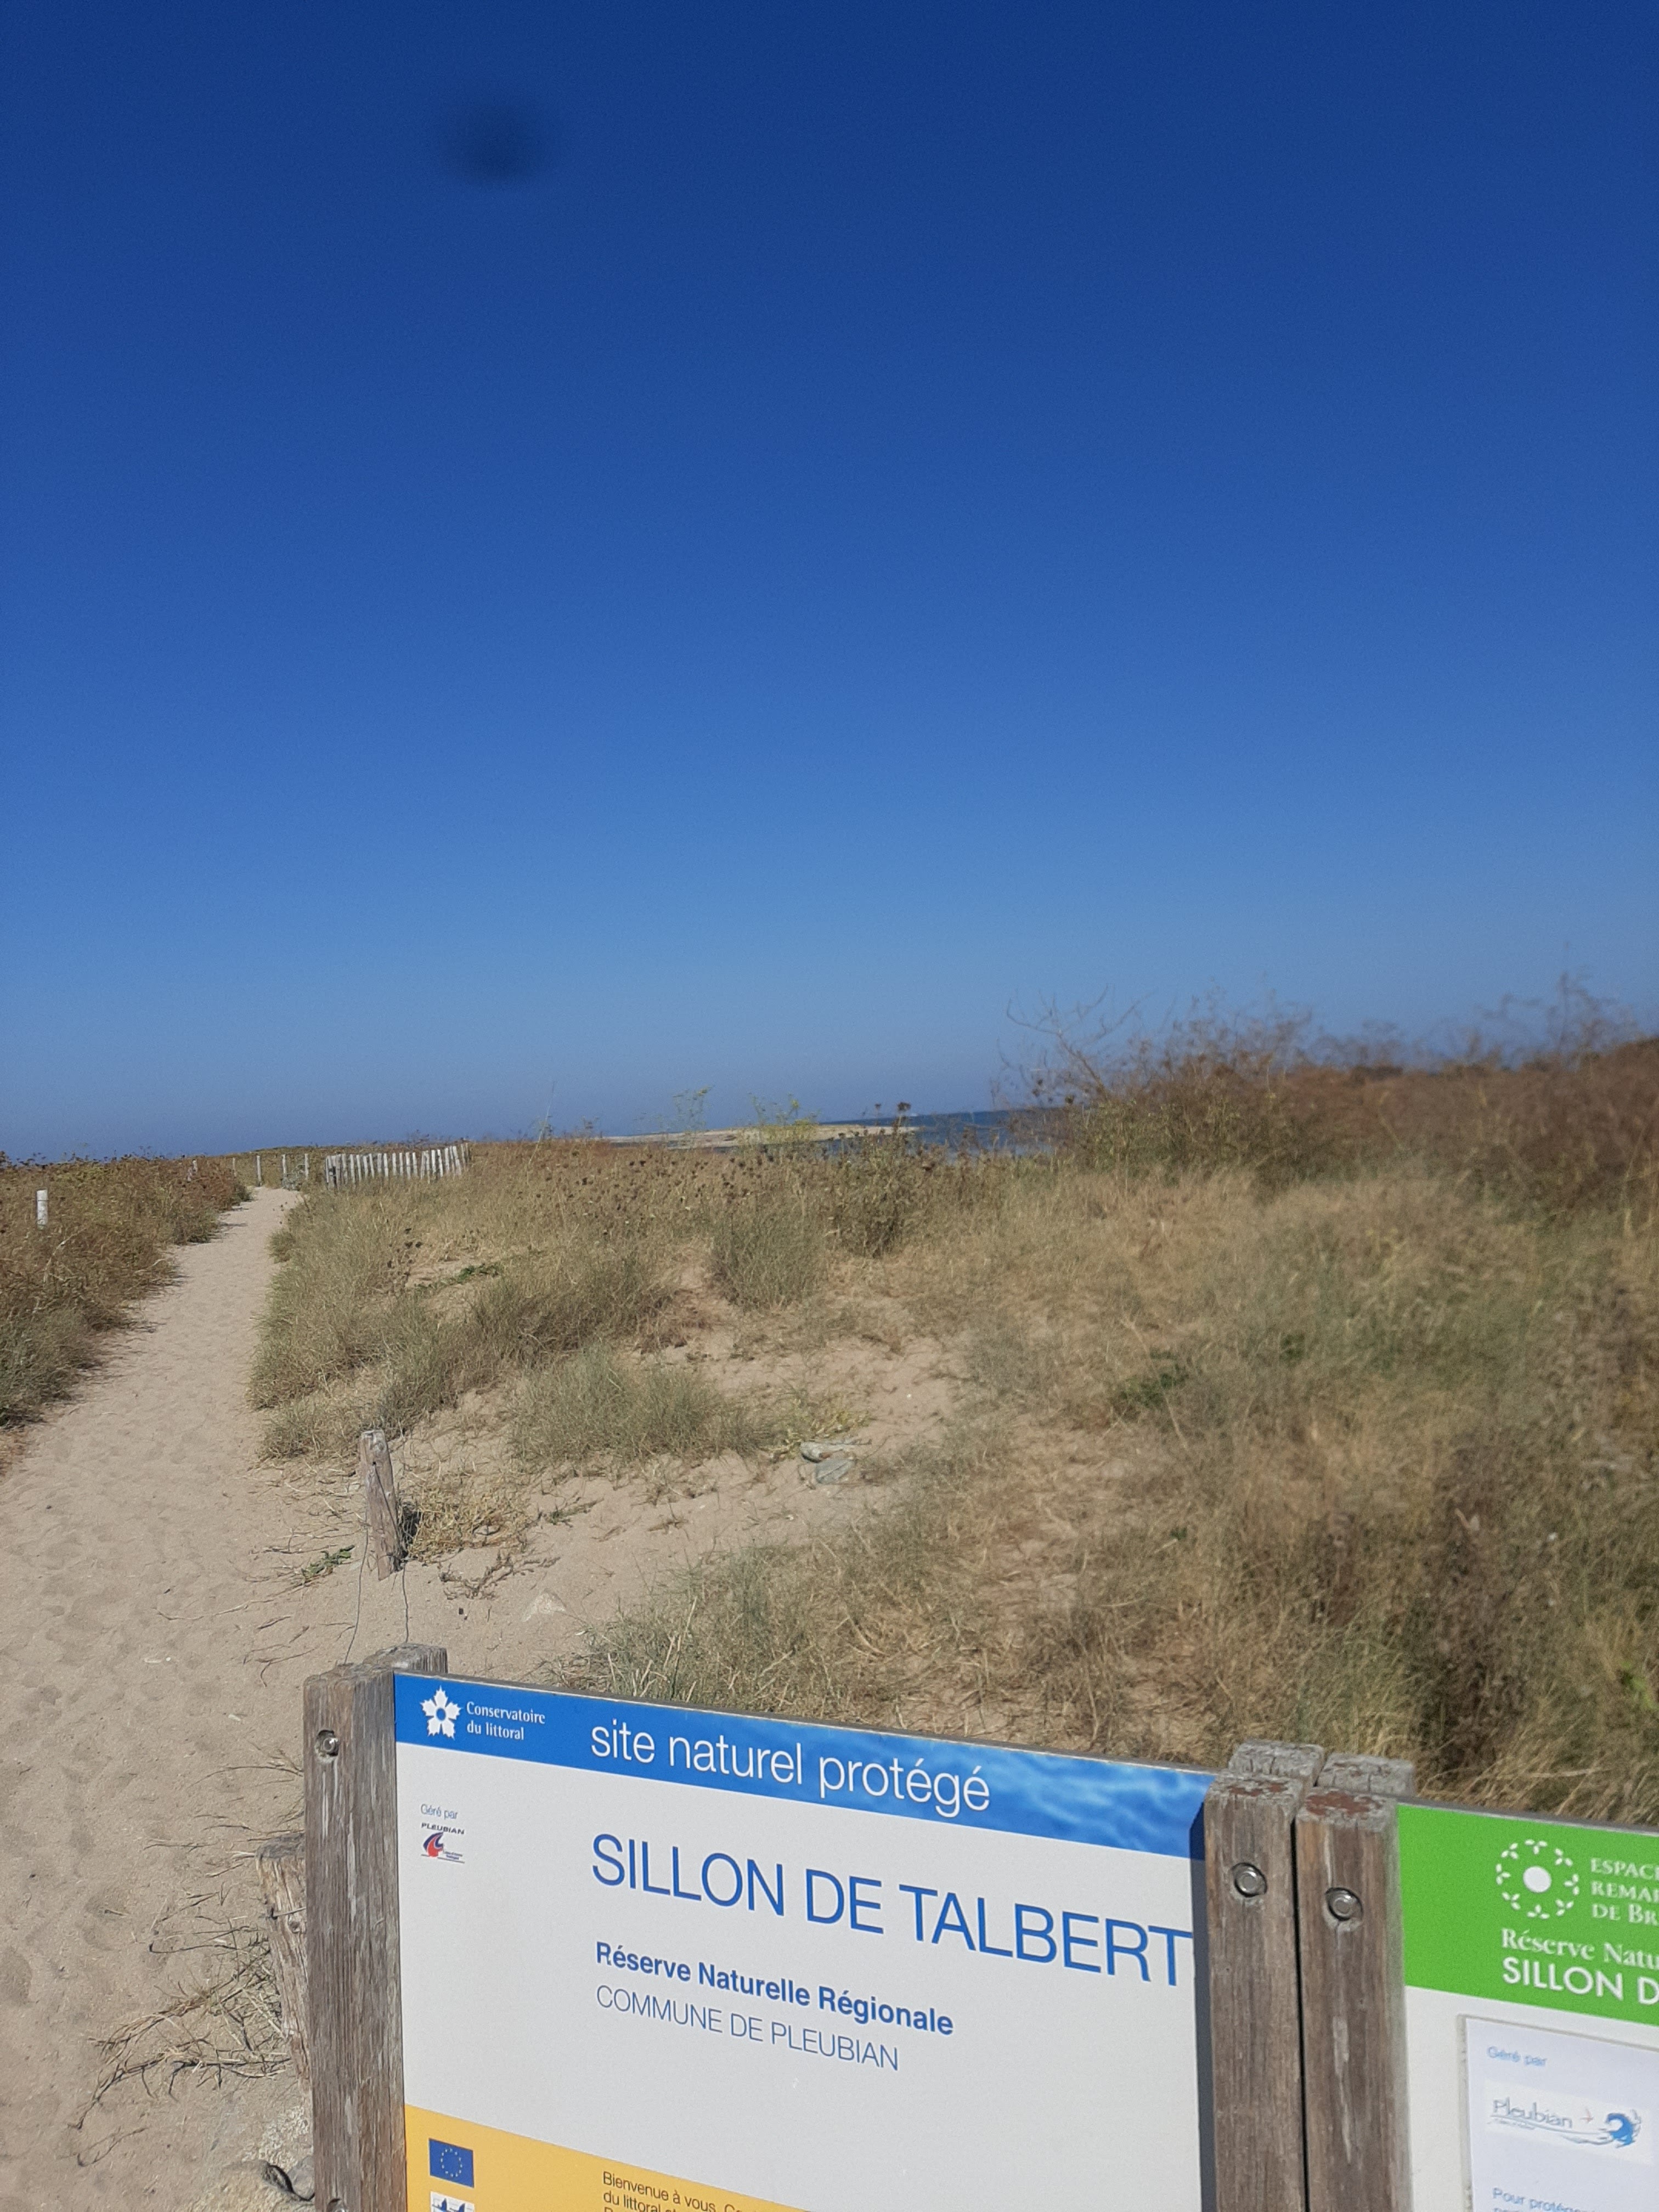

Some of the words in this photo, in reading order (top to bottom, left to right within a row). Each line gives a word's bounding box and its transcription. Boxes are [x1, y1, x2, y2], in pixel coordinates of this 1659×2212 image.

[467, 1701, 546, 1724] Conservatoire
[467, 1720, 482, 1735] du
[486, 1722, 524, 1740] littoral
[591, 1718, 655, 1764] site
[669, 1735, 802, 1785] naturel
[820, 1757, 990, 1818] protégé
[421, 1822, 465, 1835] PLEUBIAN
[444, 1810, 458, 1820] par
[592, 1833, 784, 1917] SILLON
[805, 1868, 884, 1934] DE
[899, 1883, 1193, 1987] TALBERT
[1592, 1903, 1621, 1921] DE
[1502, 1928, 1595, 1961] Réserve
[596, 1941, 691, 1982] Réserve
[698, 1962, 811, 2006] Naturelle
[819, 1985, 953, 2035] Régionale
[1503, 1956, 1623, 2001] SILLON
[597, 1984, 723, 2033] COMMUNE
[730, 2013, 763, 2042] DE
[771, 2021, 899, 2071] PLEUBIAN
[1493, 2096, 1573, 2129] Pleubian
[603, 2171, 669, 2201] Bienvenue
[673, 2190, 681, 2205] à
[603, 2190, 620, 2206] du
[624, 2194, 661, 2212] littoral
[1492, 2187, 1525, 2205] Pour
